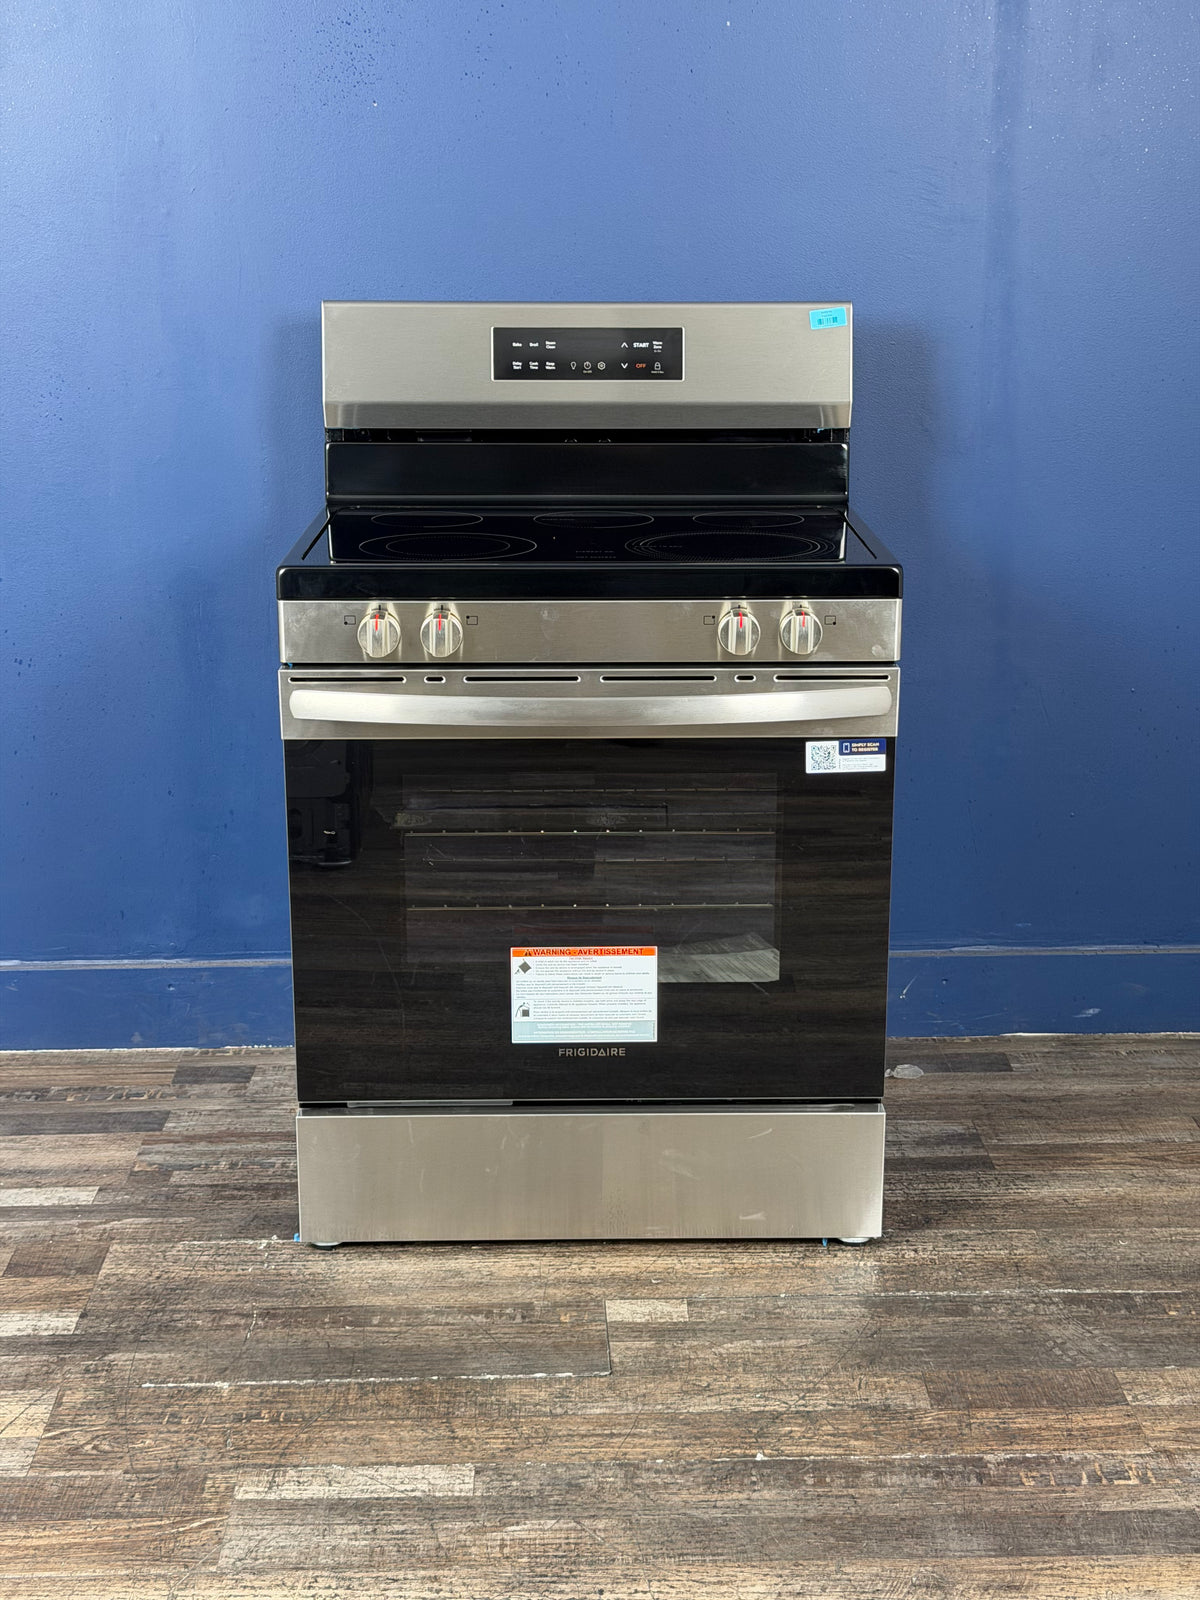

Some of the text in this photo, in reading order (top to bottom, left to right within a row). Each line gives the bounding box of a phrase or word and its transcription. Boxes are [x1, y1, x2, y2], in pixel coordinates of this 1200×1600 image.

[532, 948, 571, 956] WARNING
[577, 947, 644, 956] AVERTISSEMENT
[558, 1047, 626, 1057] FRIGIDAIRE
